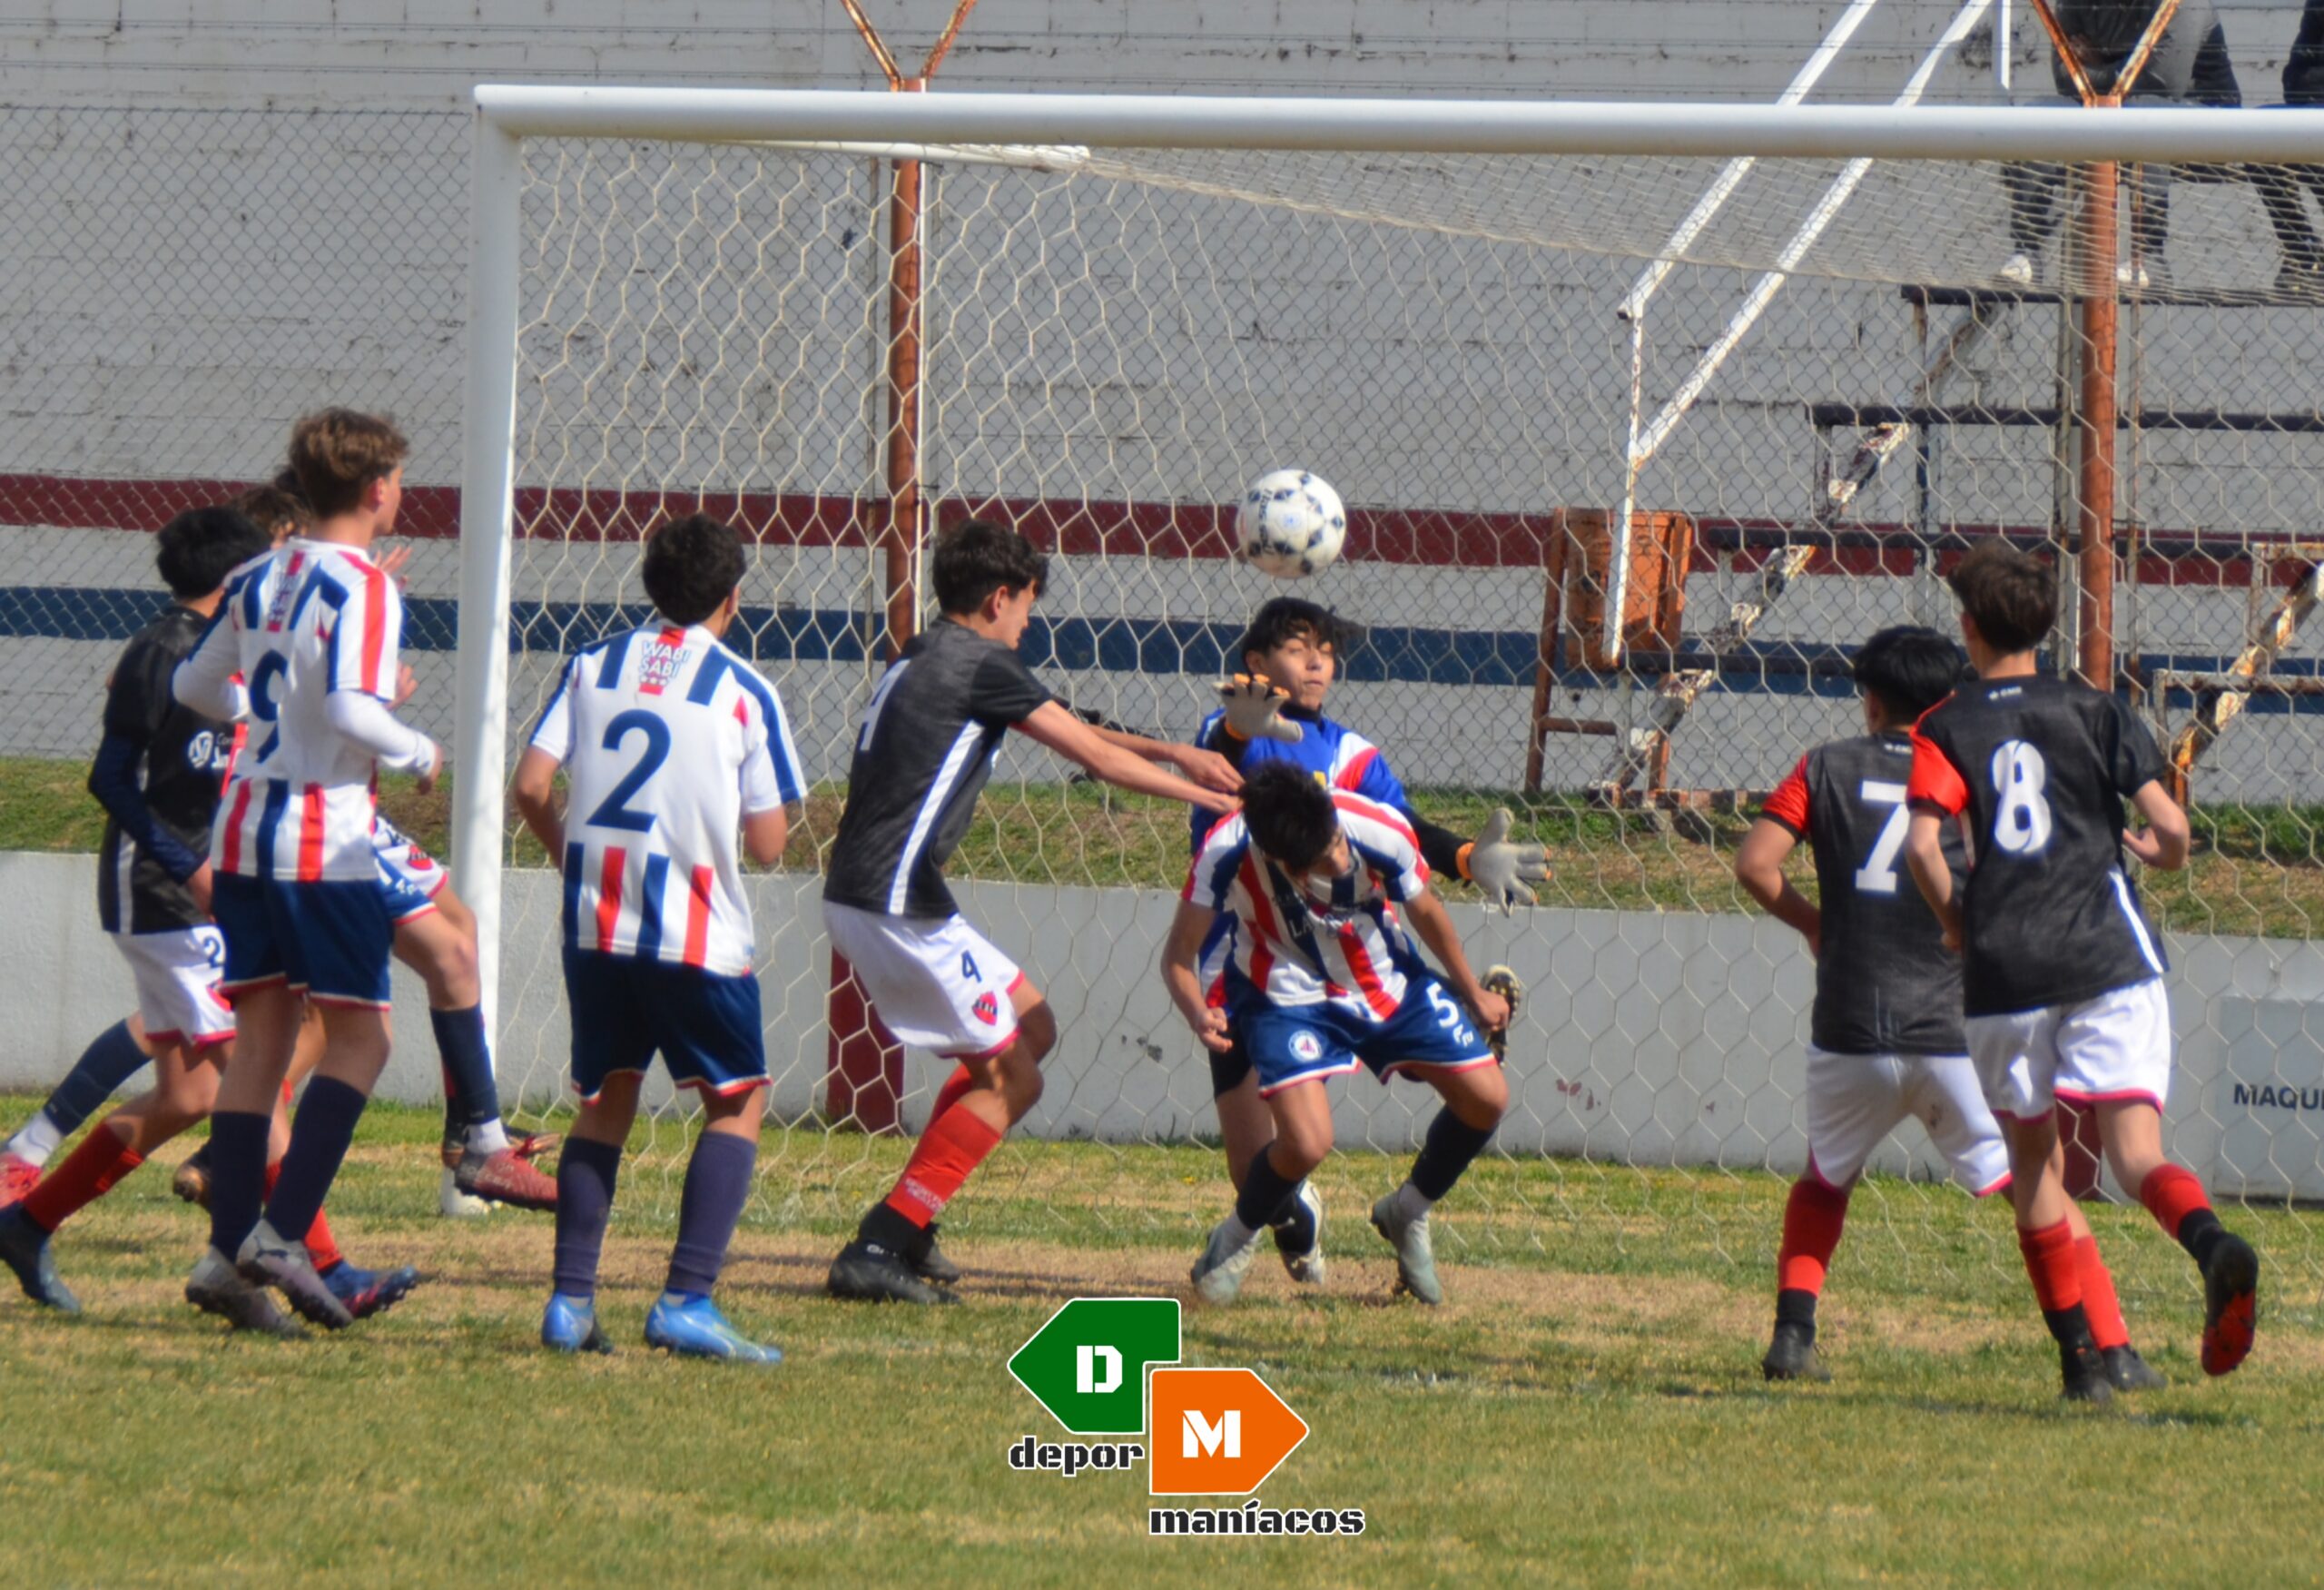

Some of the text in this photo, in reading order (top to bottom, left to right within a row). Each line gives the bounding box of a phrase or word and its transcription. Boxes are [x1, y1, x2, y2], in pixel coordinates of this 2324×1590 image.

[638, 655, 681, 680] SABI
[640, 639, 692, 663] WABI
[586, 708, 672, 834] 2
[1992, 739, 2053, 854] 8
[1856, 779, 1911, 894] 7
[960, 949, 982, 983] 4
[1426, 982, 1460, 1029] 5
